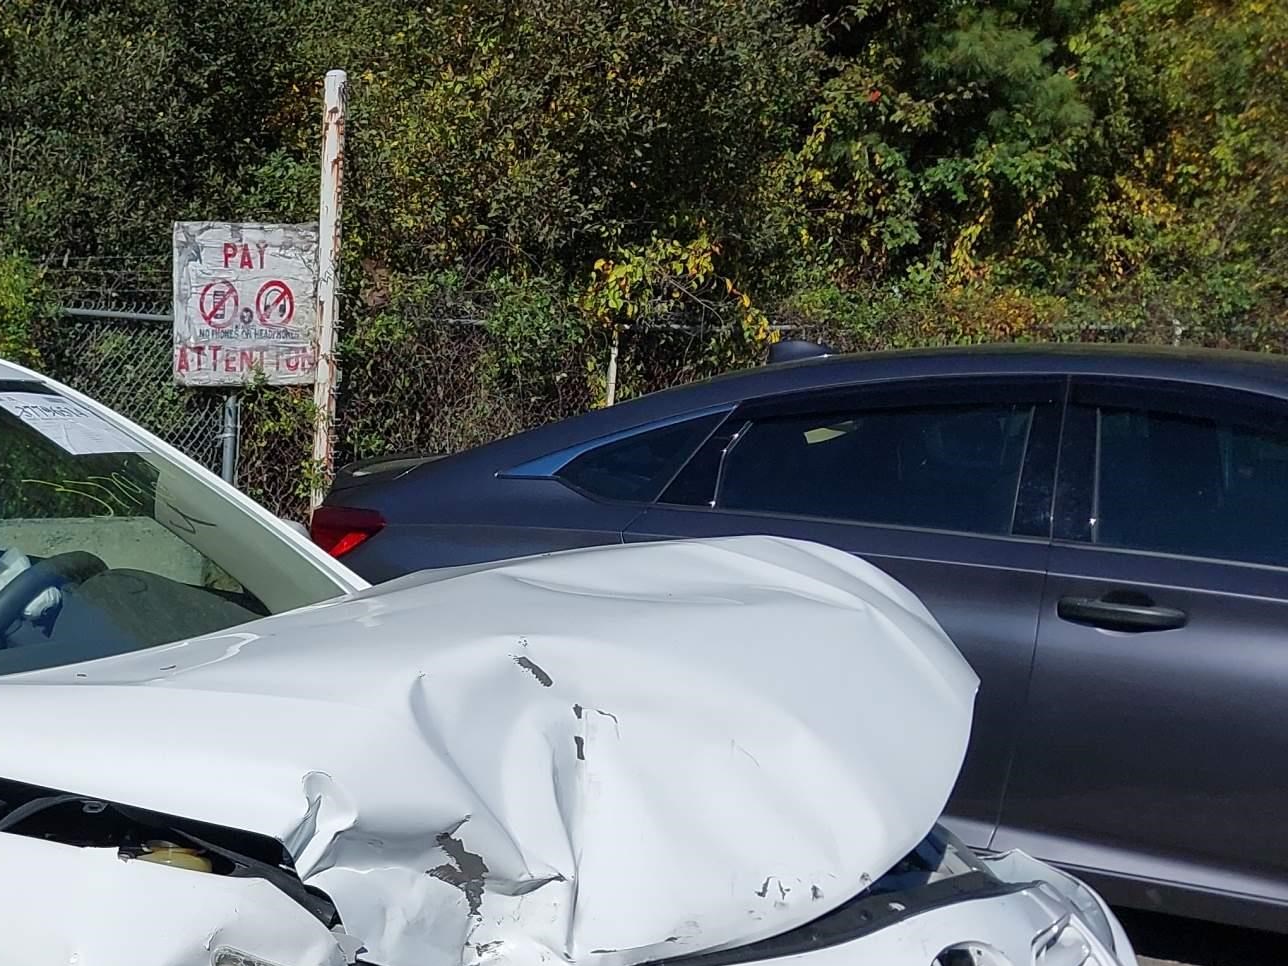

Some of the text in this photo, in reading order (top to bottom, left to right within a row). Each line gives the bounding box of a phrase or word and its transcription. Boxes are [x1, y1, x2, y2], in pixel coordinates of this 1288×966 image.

[223, 241, 268, 270] PAY
[199, 329, 210, 339] NO
[211, 328, 239, 340] PHONES
[241, 328, 252, 340] OR
[177, 345, 314, 373] ATTENTION
